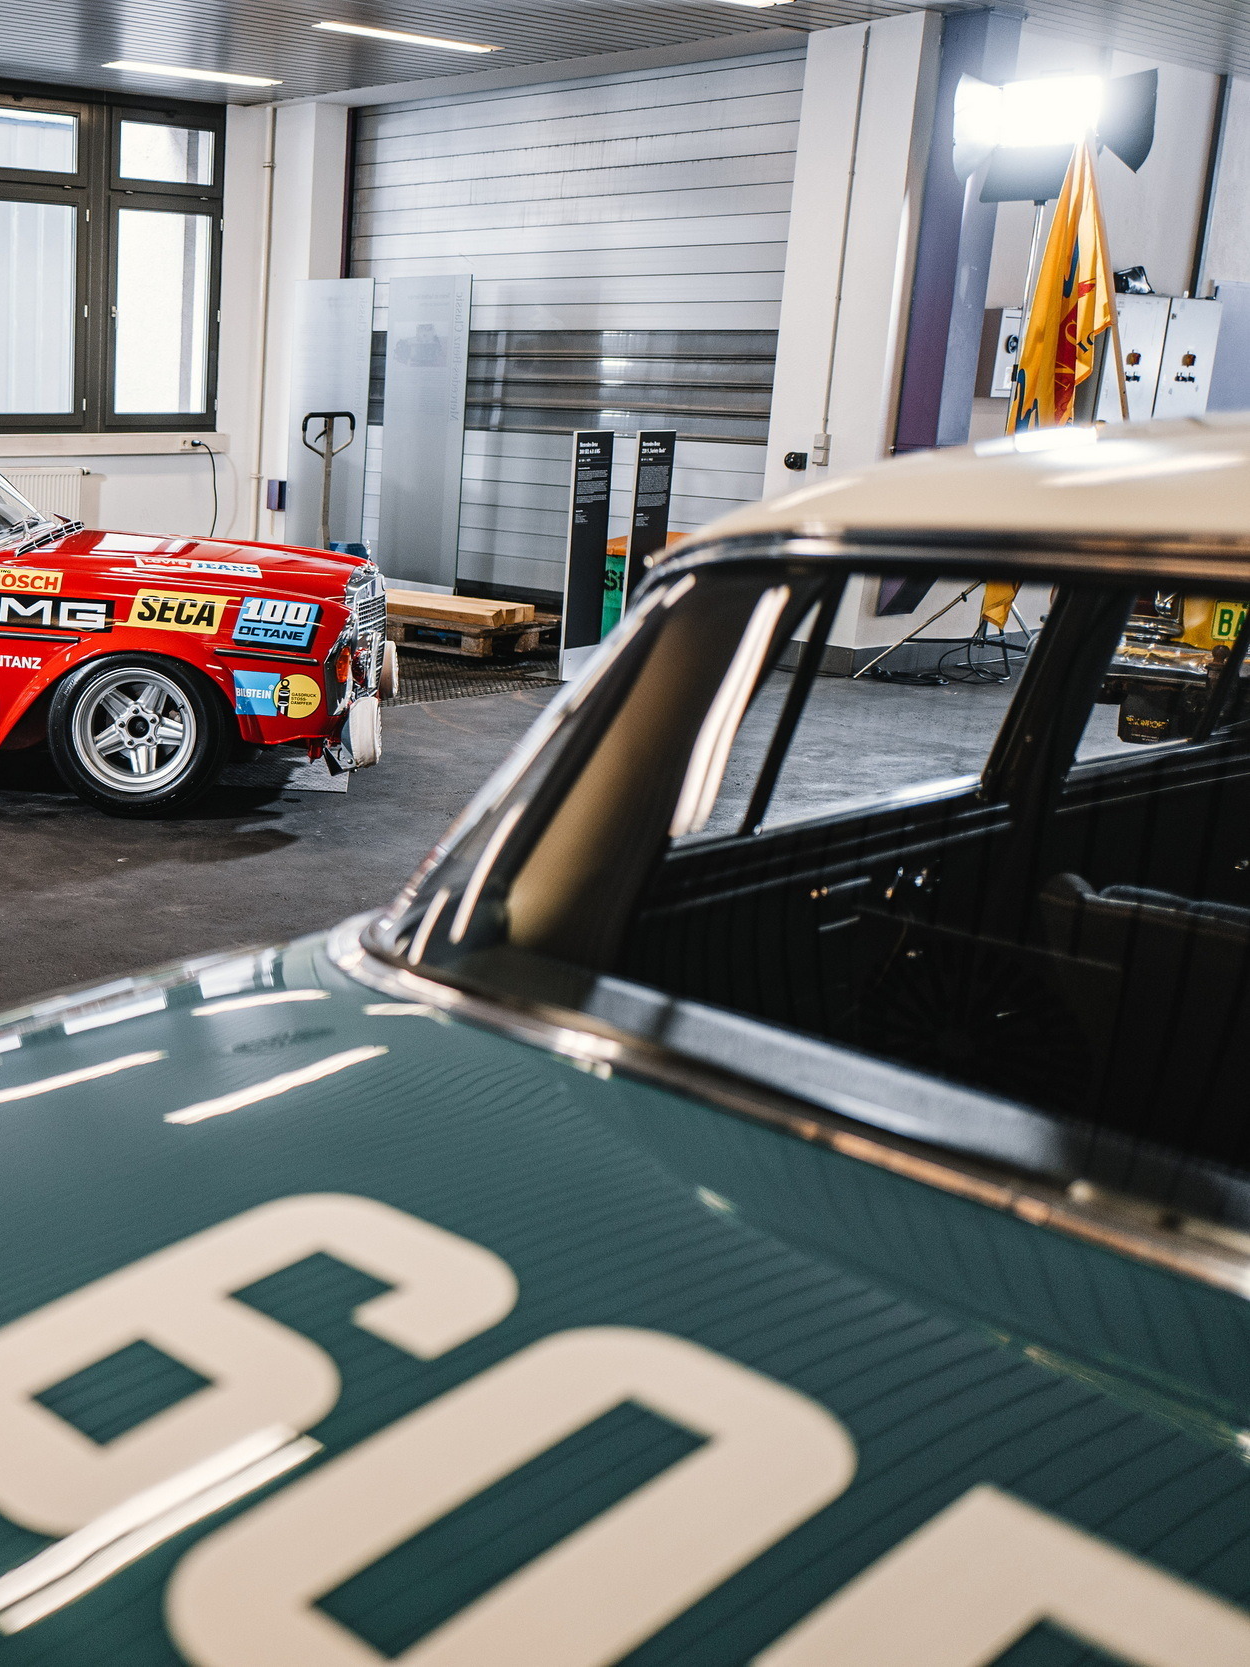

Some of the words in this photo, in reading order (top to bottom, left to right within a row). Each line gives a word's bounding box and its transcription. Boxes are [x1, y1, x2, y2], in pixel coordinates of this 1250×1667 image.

[137, 595, 216, 627] SECA
[242, 599, 312, 626] 100
[238, 625, 305, 642] OCTANE
[236, 687, 272, 700] BILSTEIN
